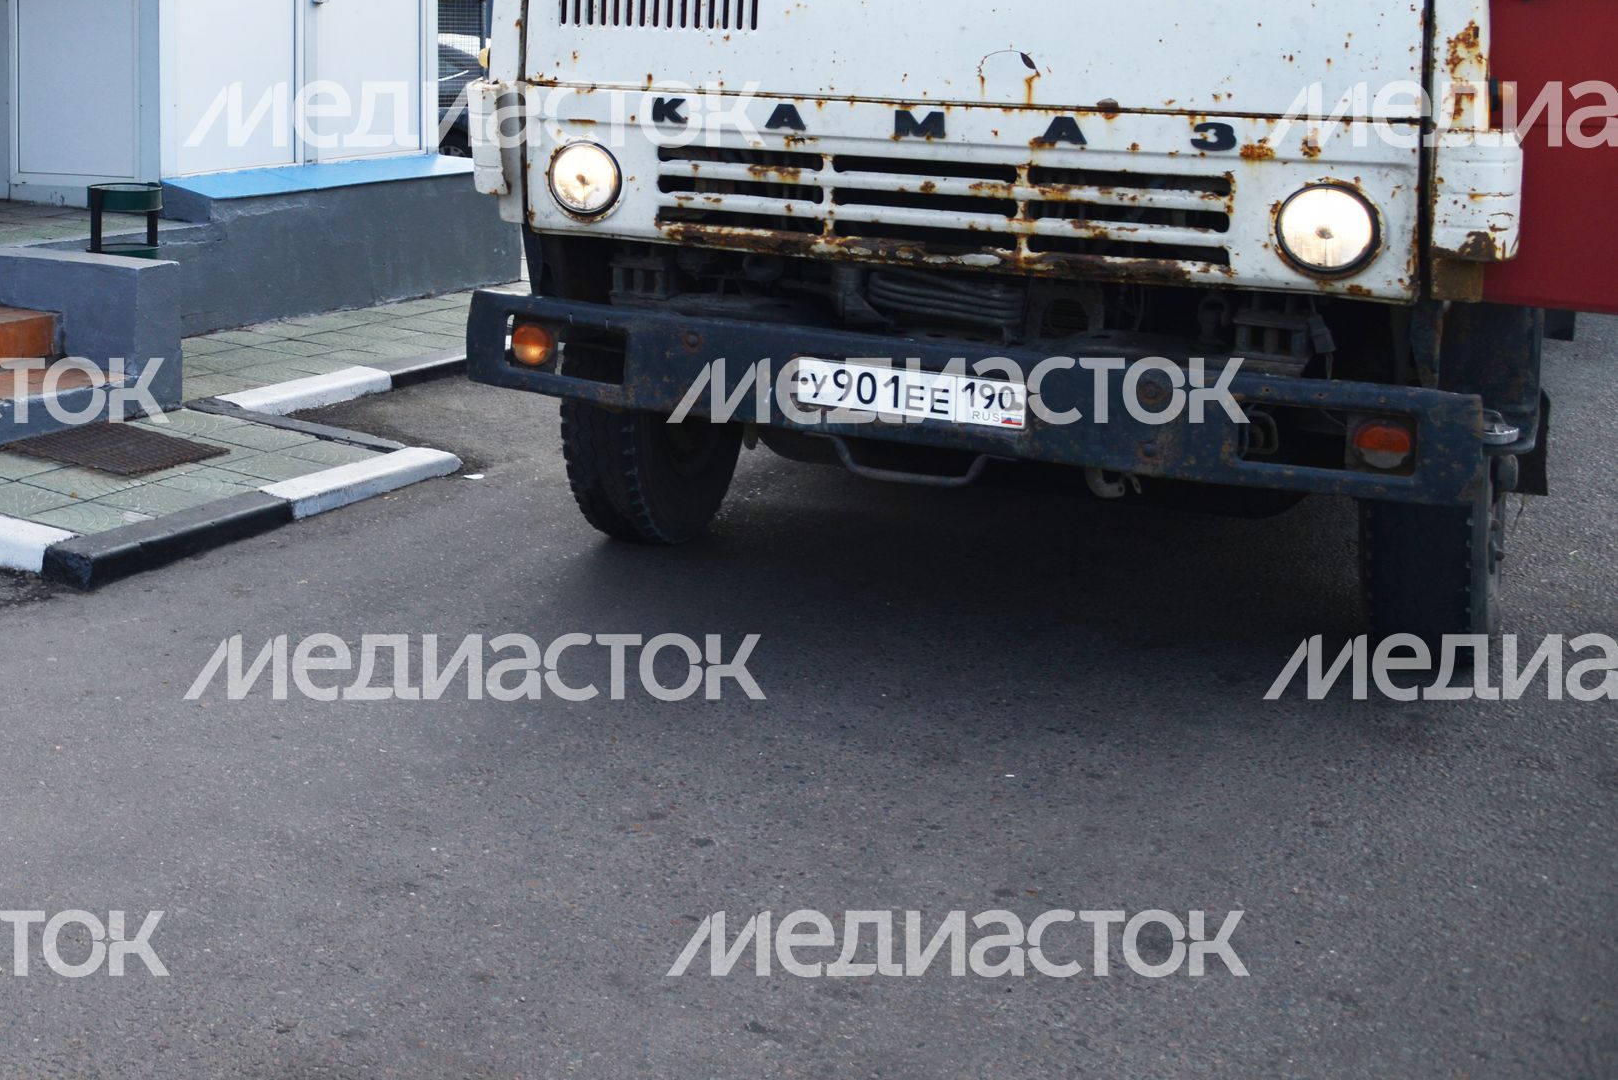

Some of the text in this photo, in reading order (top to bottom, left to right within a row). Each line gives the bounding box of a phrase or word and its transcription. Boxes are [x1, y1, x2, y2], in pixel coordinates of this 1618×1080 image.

[651, 97, 1237, 152] КАМАЗ
[961, 381, 1016, 412] 190
[972, 410, 1000, 423] RUS
